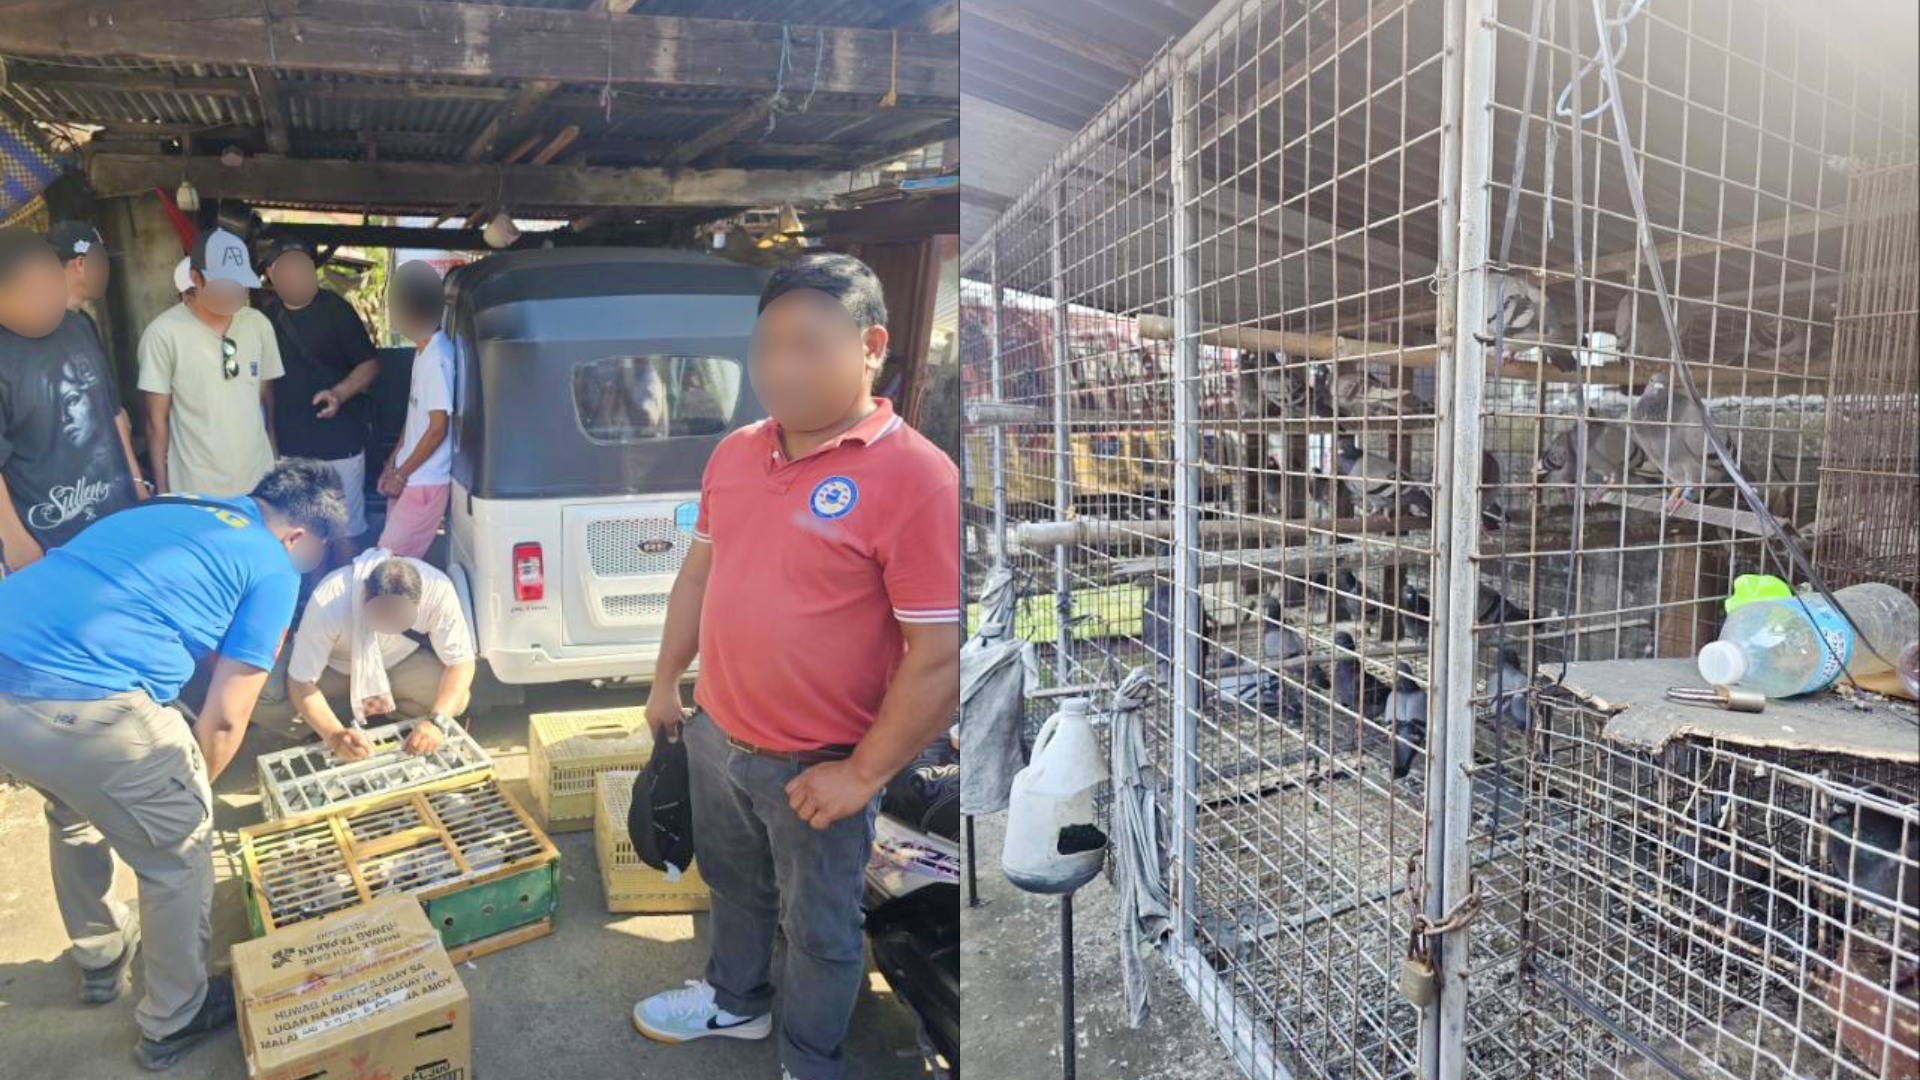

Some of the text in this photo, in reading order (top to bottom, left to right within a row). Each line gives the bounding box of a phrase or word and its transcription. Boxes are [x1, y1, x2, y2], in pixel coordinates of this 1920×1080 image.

[304, 953, 331, 965] CARE
[275, 1001, 319, 1020] HUWAG
[410, 963, 425, 974] SA
[422, 976, 451, 994] AMOY
[267, 1017, 308, 1035] LUGAR
[311, 1010, 328, 1021] NA
[330, 1003, 354, 1016] MAY
[357, 991, 382, 1006] MGA
